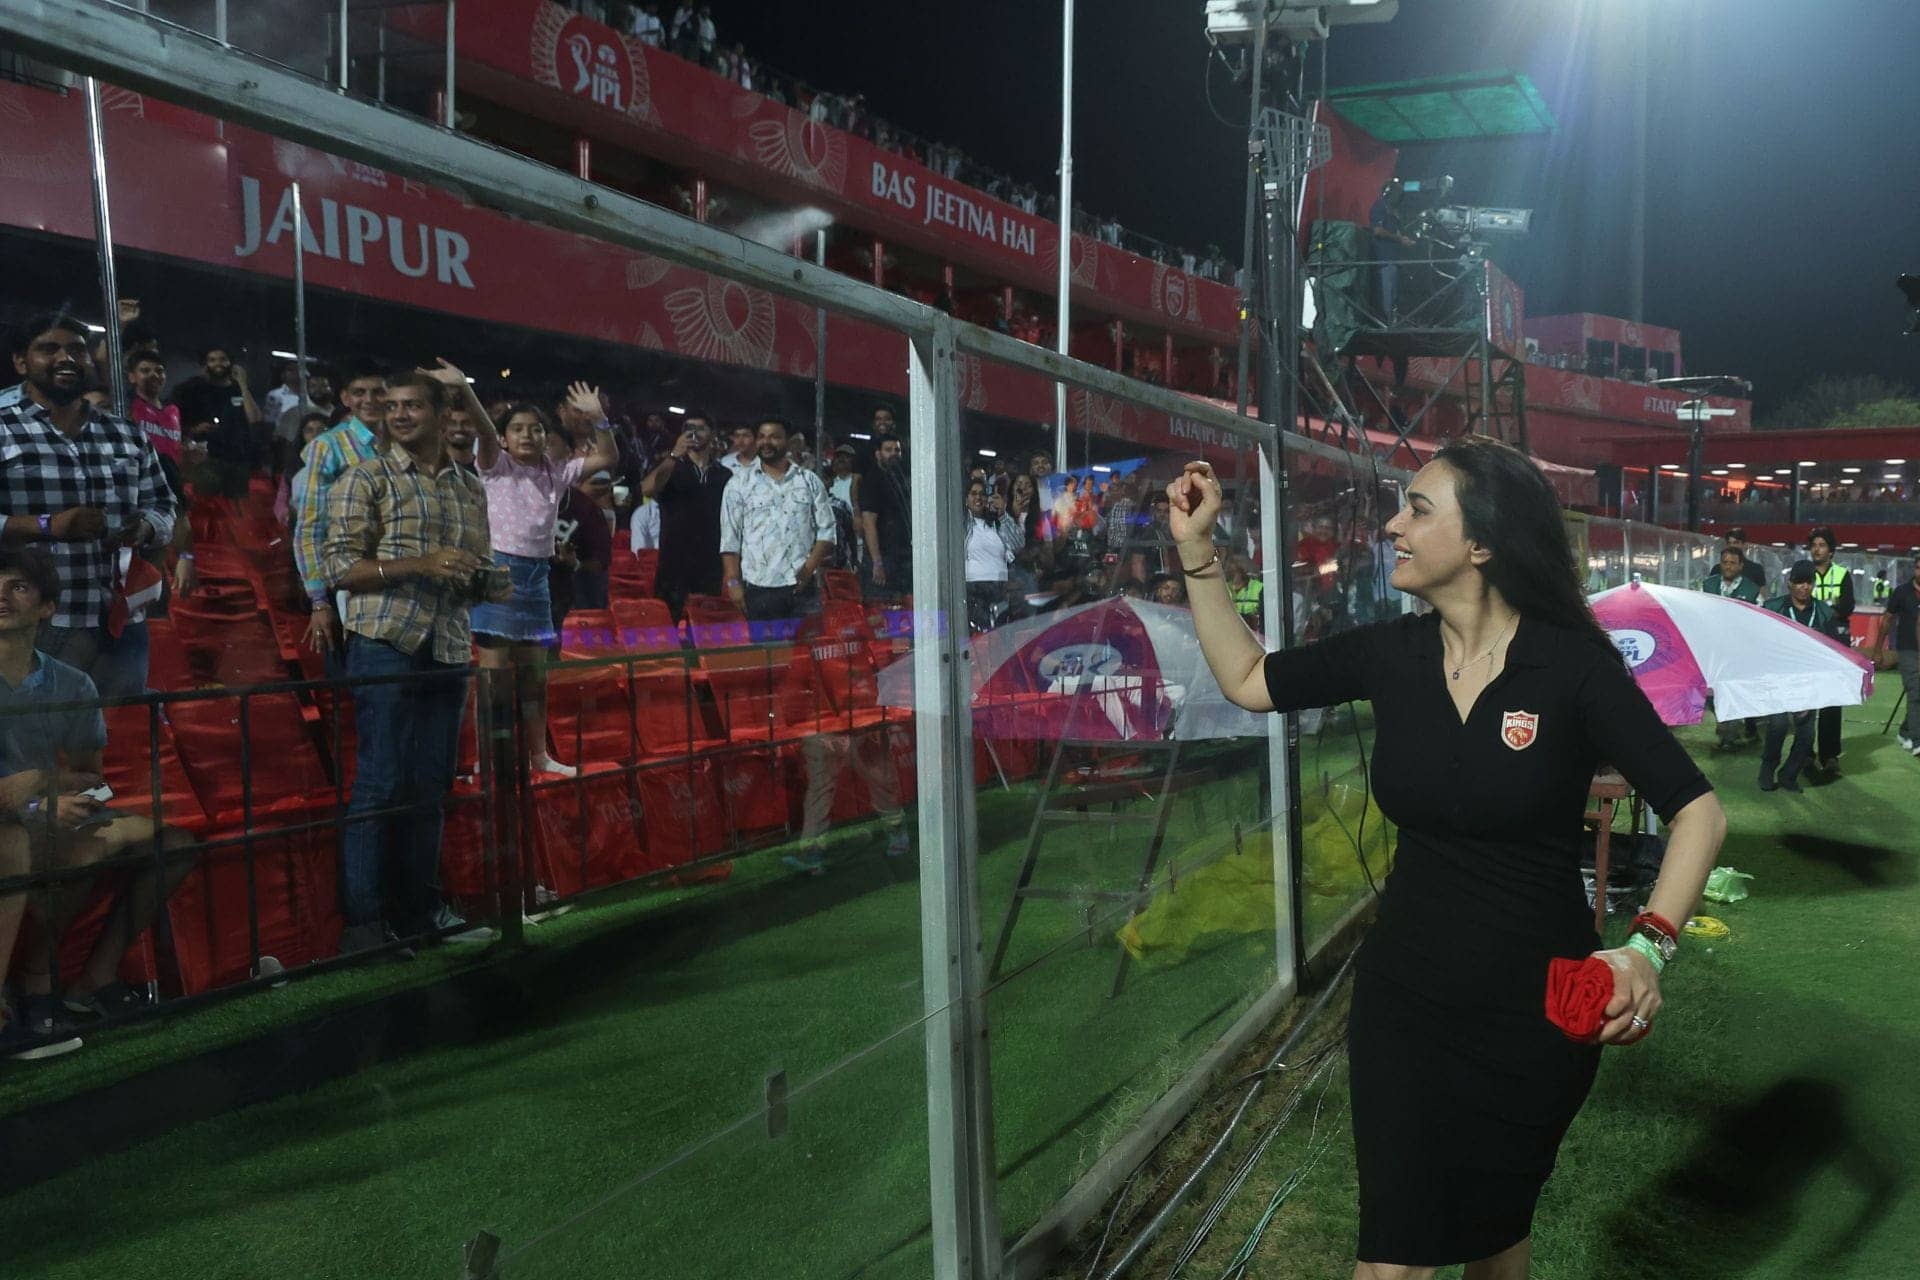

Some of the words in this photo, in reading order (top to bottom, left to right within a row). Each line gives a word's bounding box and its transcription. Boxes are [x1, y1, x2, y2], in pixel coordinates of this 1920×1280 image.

[592, 73, 626, 112] IPL
[234, 175, 476, 289] JAIPUR
[872, 161, 916, 209] BAS
[924, 184, 996, 242] JEETNA
[1003, 216, 1036, 256] HAI
[1506, 719, 1534, 730] KINGS
